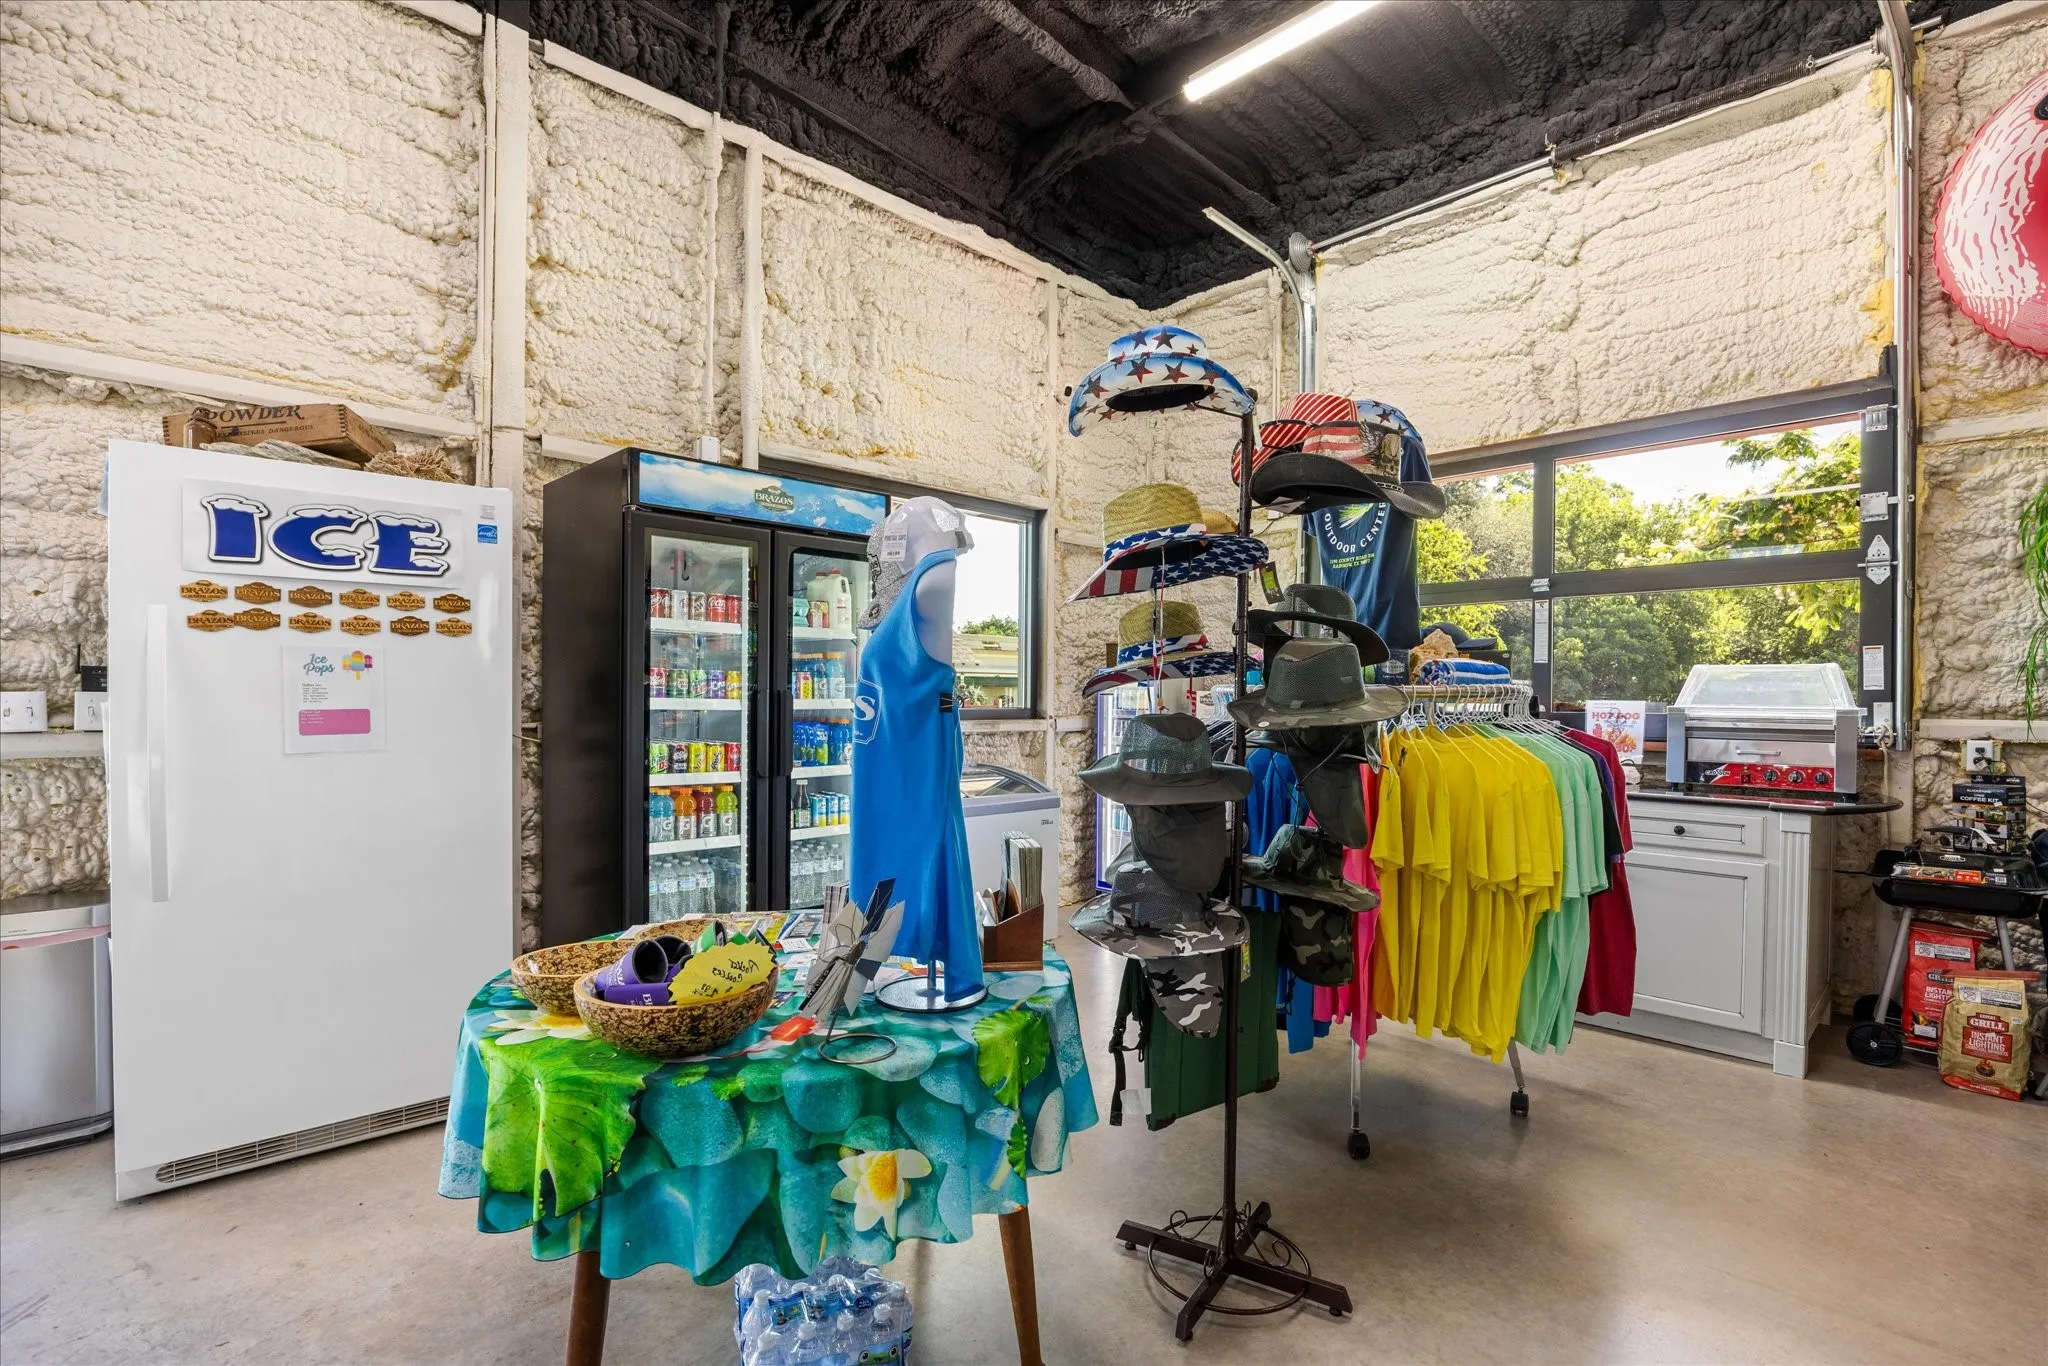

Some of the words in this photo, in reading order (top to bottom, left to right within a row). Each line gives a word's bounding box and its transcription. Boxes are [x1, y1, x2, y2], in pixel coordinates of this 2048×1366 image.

[268, 424, 314, 434] DANGEROUS
[755, 492, 794, 506] BRAZOS
[201, 493, 449, 576] ICE
[1324, 512, 1356, 553] OUTDOOR
[236, 588, 280, 597] BRAZOS
[308, 653, 328, 664] Ice
[303, 663, 335, 676] Pops
[1926, 986, 1953, 996] INSTAN
[1970, 1018, 2006, 1031] GRILL
[1971, 1030, 2005, 1044] INSTANT
[1969, 1038, 2006, 1052] LIGHTING
